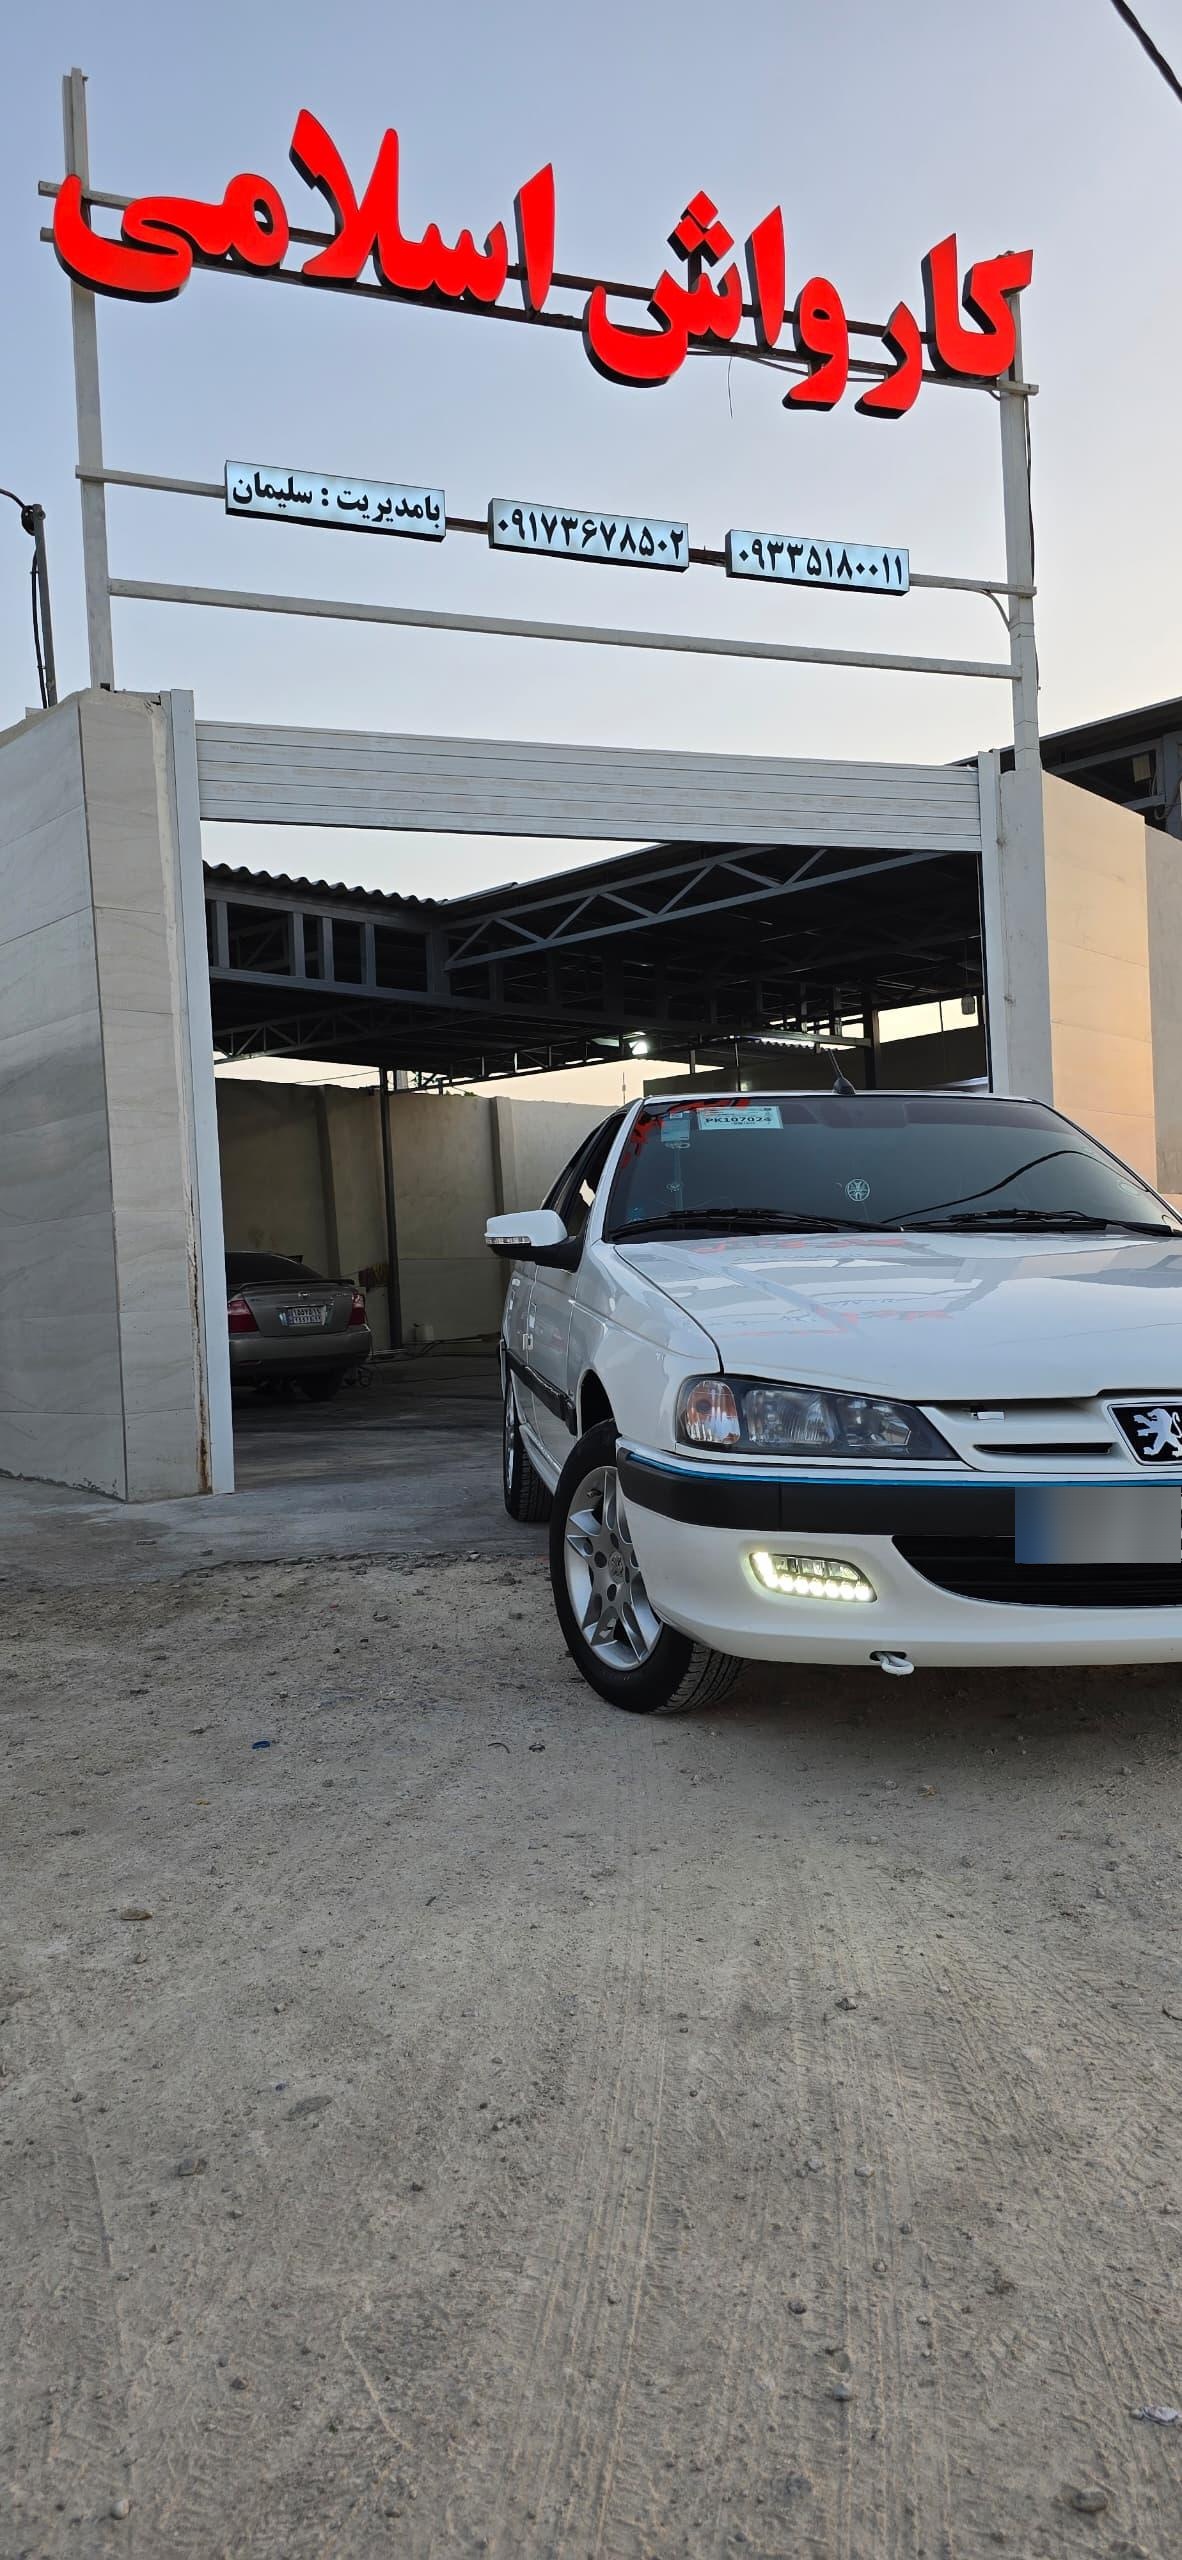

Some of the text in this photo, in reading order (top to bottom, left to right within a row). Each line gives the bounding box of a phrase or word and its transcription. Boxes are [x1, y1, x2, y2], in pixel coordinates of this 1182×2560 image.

[52, 109, 556, 309] اسلامی
[232, 471, 313, 509] سلیمان
[336, 490, 441, 529] بامدیریت
[498, 508, 684, 560] ۰۹۱۷۳۶۷۸۵۰۲
[738, 538, 903, 585] ۰۹۳۳۵۱۸۰۰۱۱
